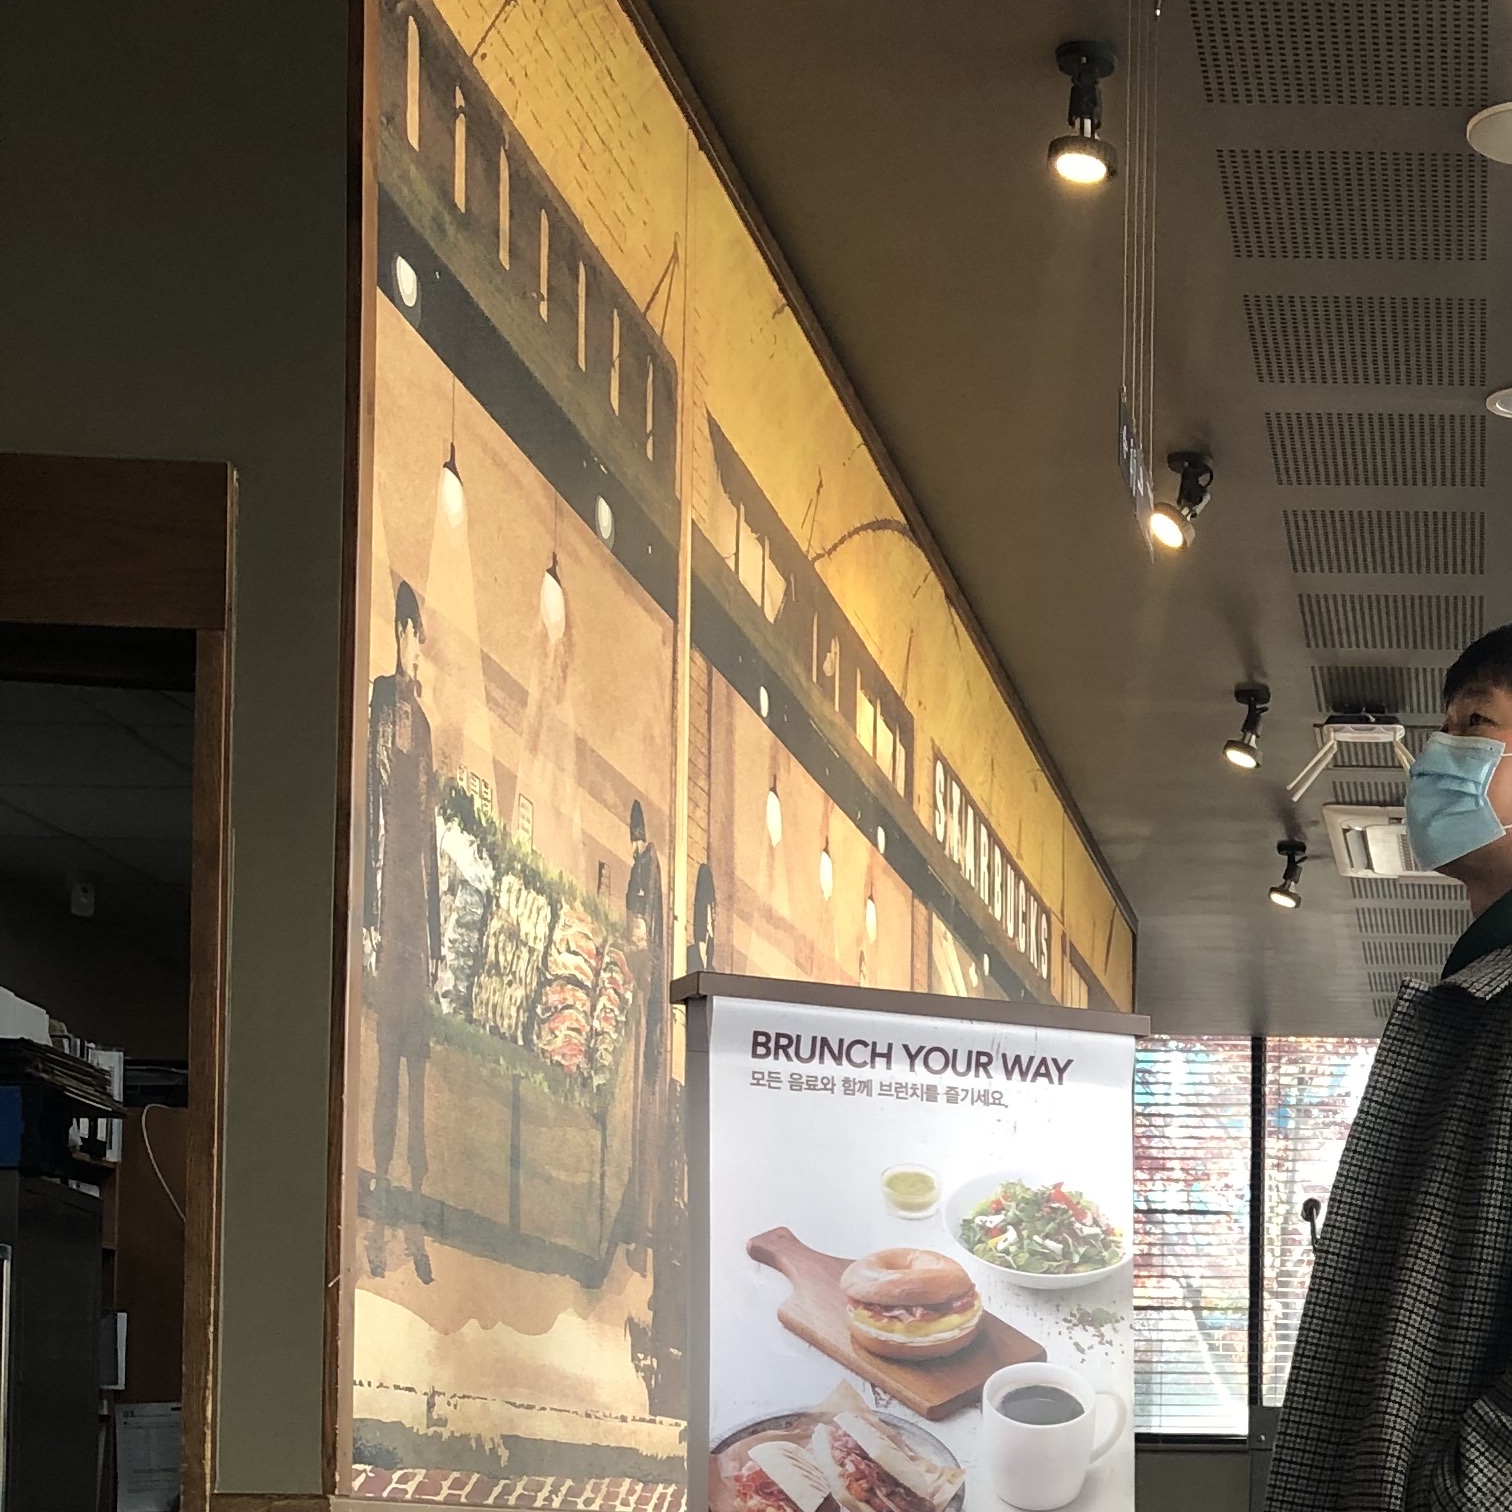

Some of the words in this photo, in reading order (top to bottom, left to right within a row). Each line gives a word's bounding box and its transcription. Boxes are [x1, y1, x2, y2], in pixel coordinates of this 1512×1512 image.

[751, 1030, 894, 1071] BRUNCH
[902, 1044, 994, 1079] YOUR
[1001, 1053, 1073, 1085] WAY
[750, 1070, 784, 1090] 모든
[787, 1072, 836, 1095] 음료와
[841, 1076, 873, 1097] 함께
[878, 1081, 940, 1103] 브런치를
[944, 1087, 1009, 1109] 즐기세요.
